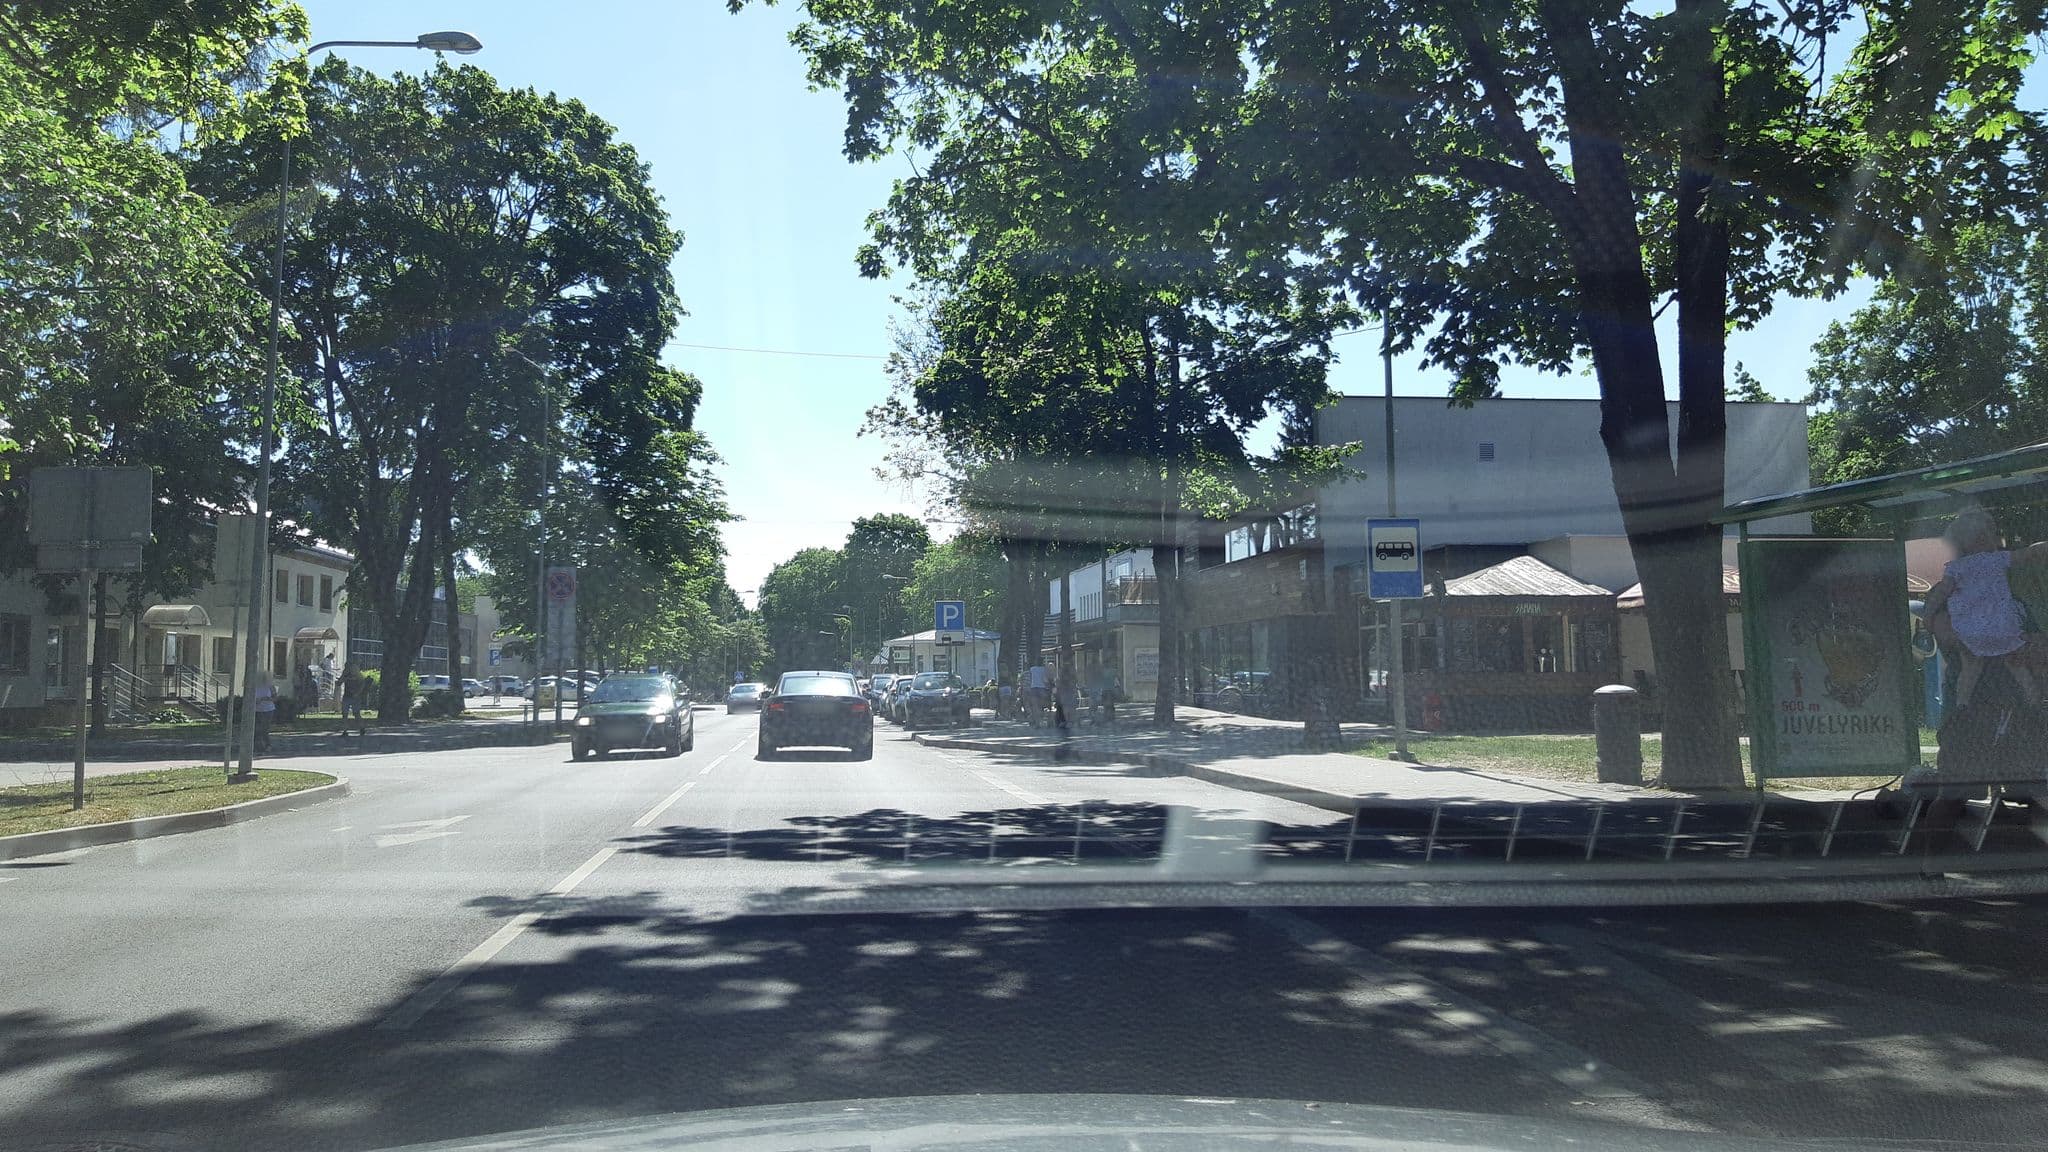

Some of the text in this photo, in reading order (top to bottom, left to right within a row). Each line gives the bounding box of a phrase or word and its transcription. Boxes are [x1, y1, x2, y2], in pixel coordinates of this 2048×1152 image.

[943, 604, 959, 628] P
[1782, 701, 1820, 712] 500 m
[1783, 714, 1894, 735] JUVELYRIKA
